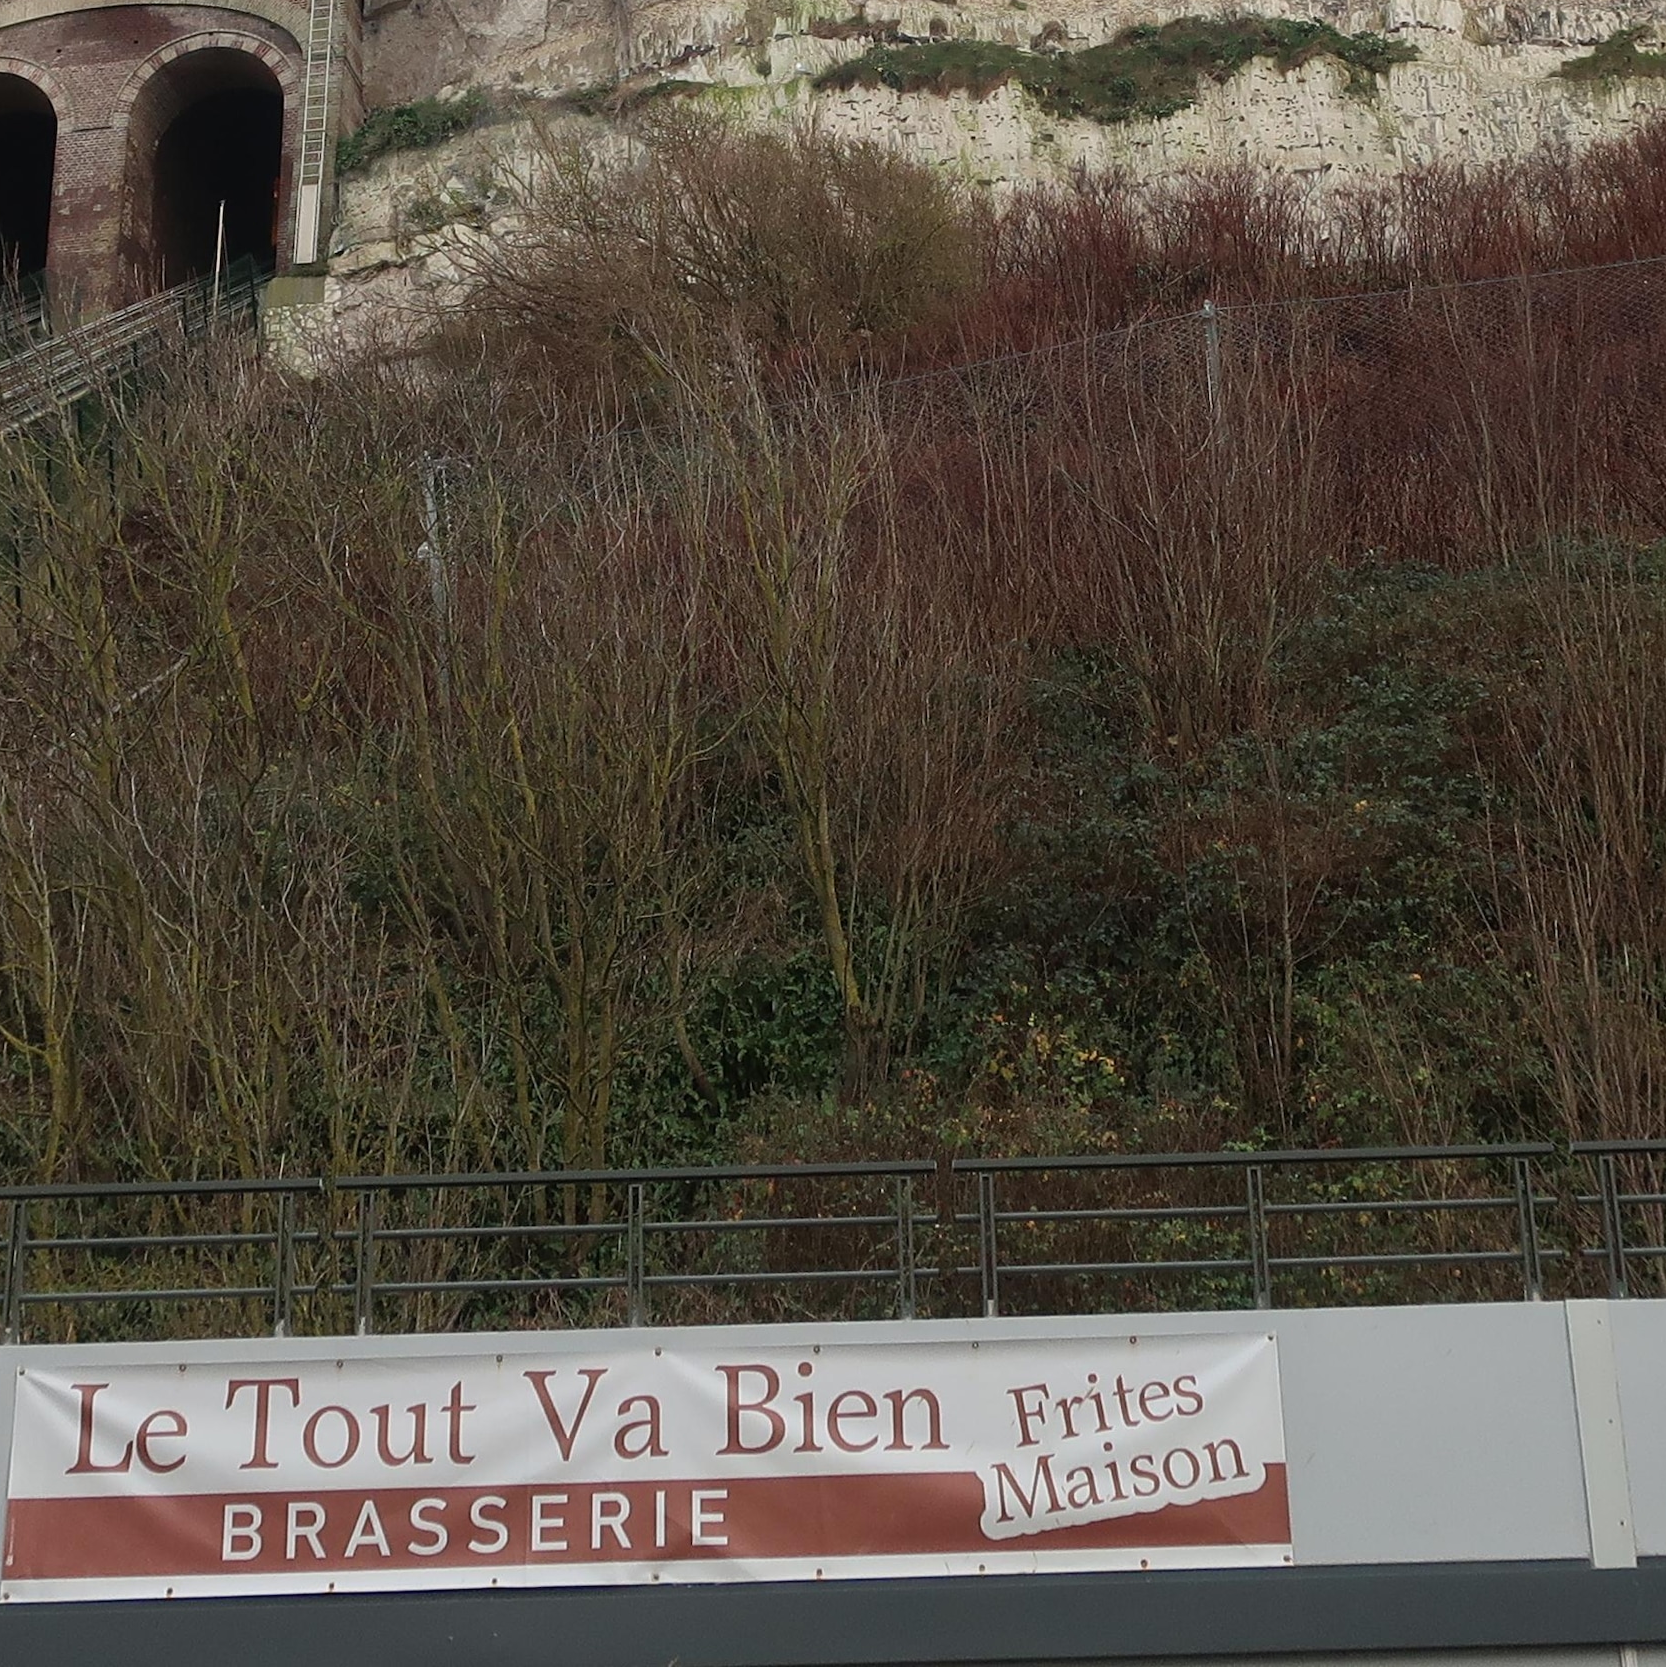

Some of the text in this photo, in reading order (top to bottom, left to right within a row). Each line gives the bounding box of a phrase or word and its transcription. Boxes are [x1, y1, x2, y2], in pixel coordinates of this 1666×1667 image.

[64, 1361, 951, 1475] Le Tout Va Bien
[1006, 1373, 1204, 1448] Frites
[989, 1437, 1251, 1524] Maison
[221, 1488, 730, 1562] BRASSERIE
